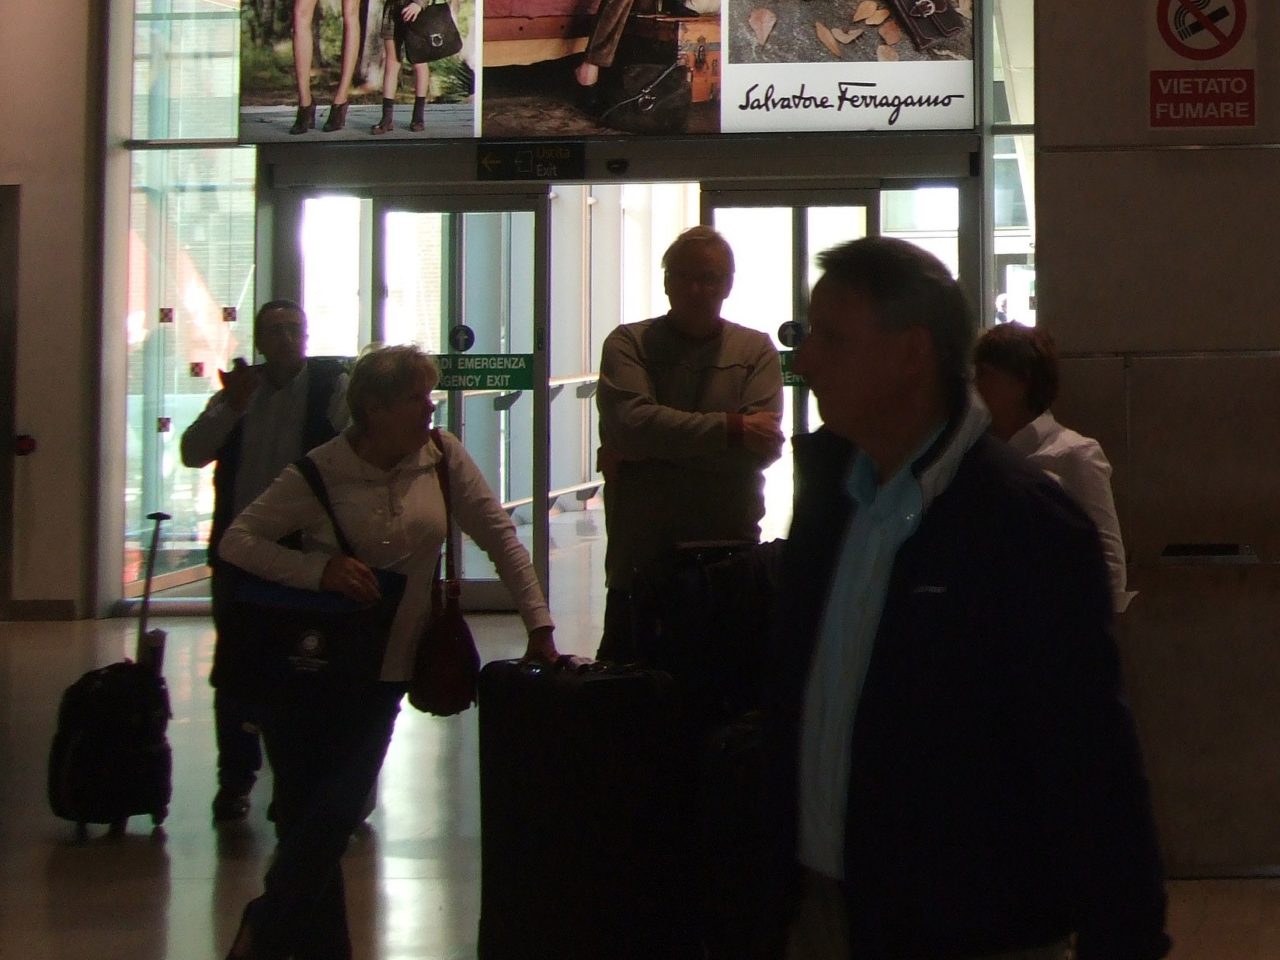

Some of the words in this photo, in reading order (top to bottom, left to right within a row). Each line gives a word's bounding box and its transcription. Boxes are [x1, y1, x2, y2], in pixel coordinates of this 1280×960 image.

[1157, 76, 1247, 95] VIETATO
[739, 83, 835, 112] Salvatore
[838, 81, 965, 126] Ferragamo
[1155, 101, 1250, 120] FUMARE
[457, 357, 526, 370] EMERGENZA
[486, 374, 512, 387] EXIT
